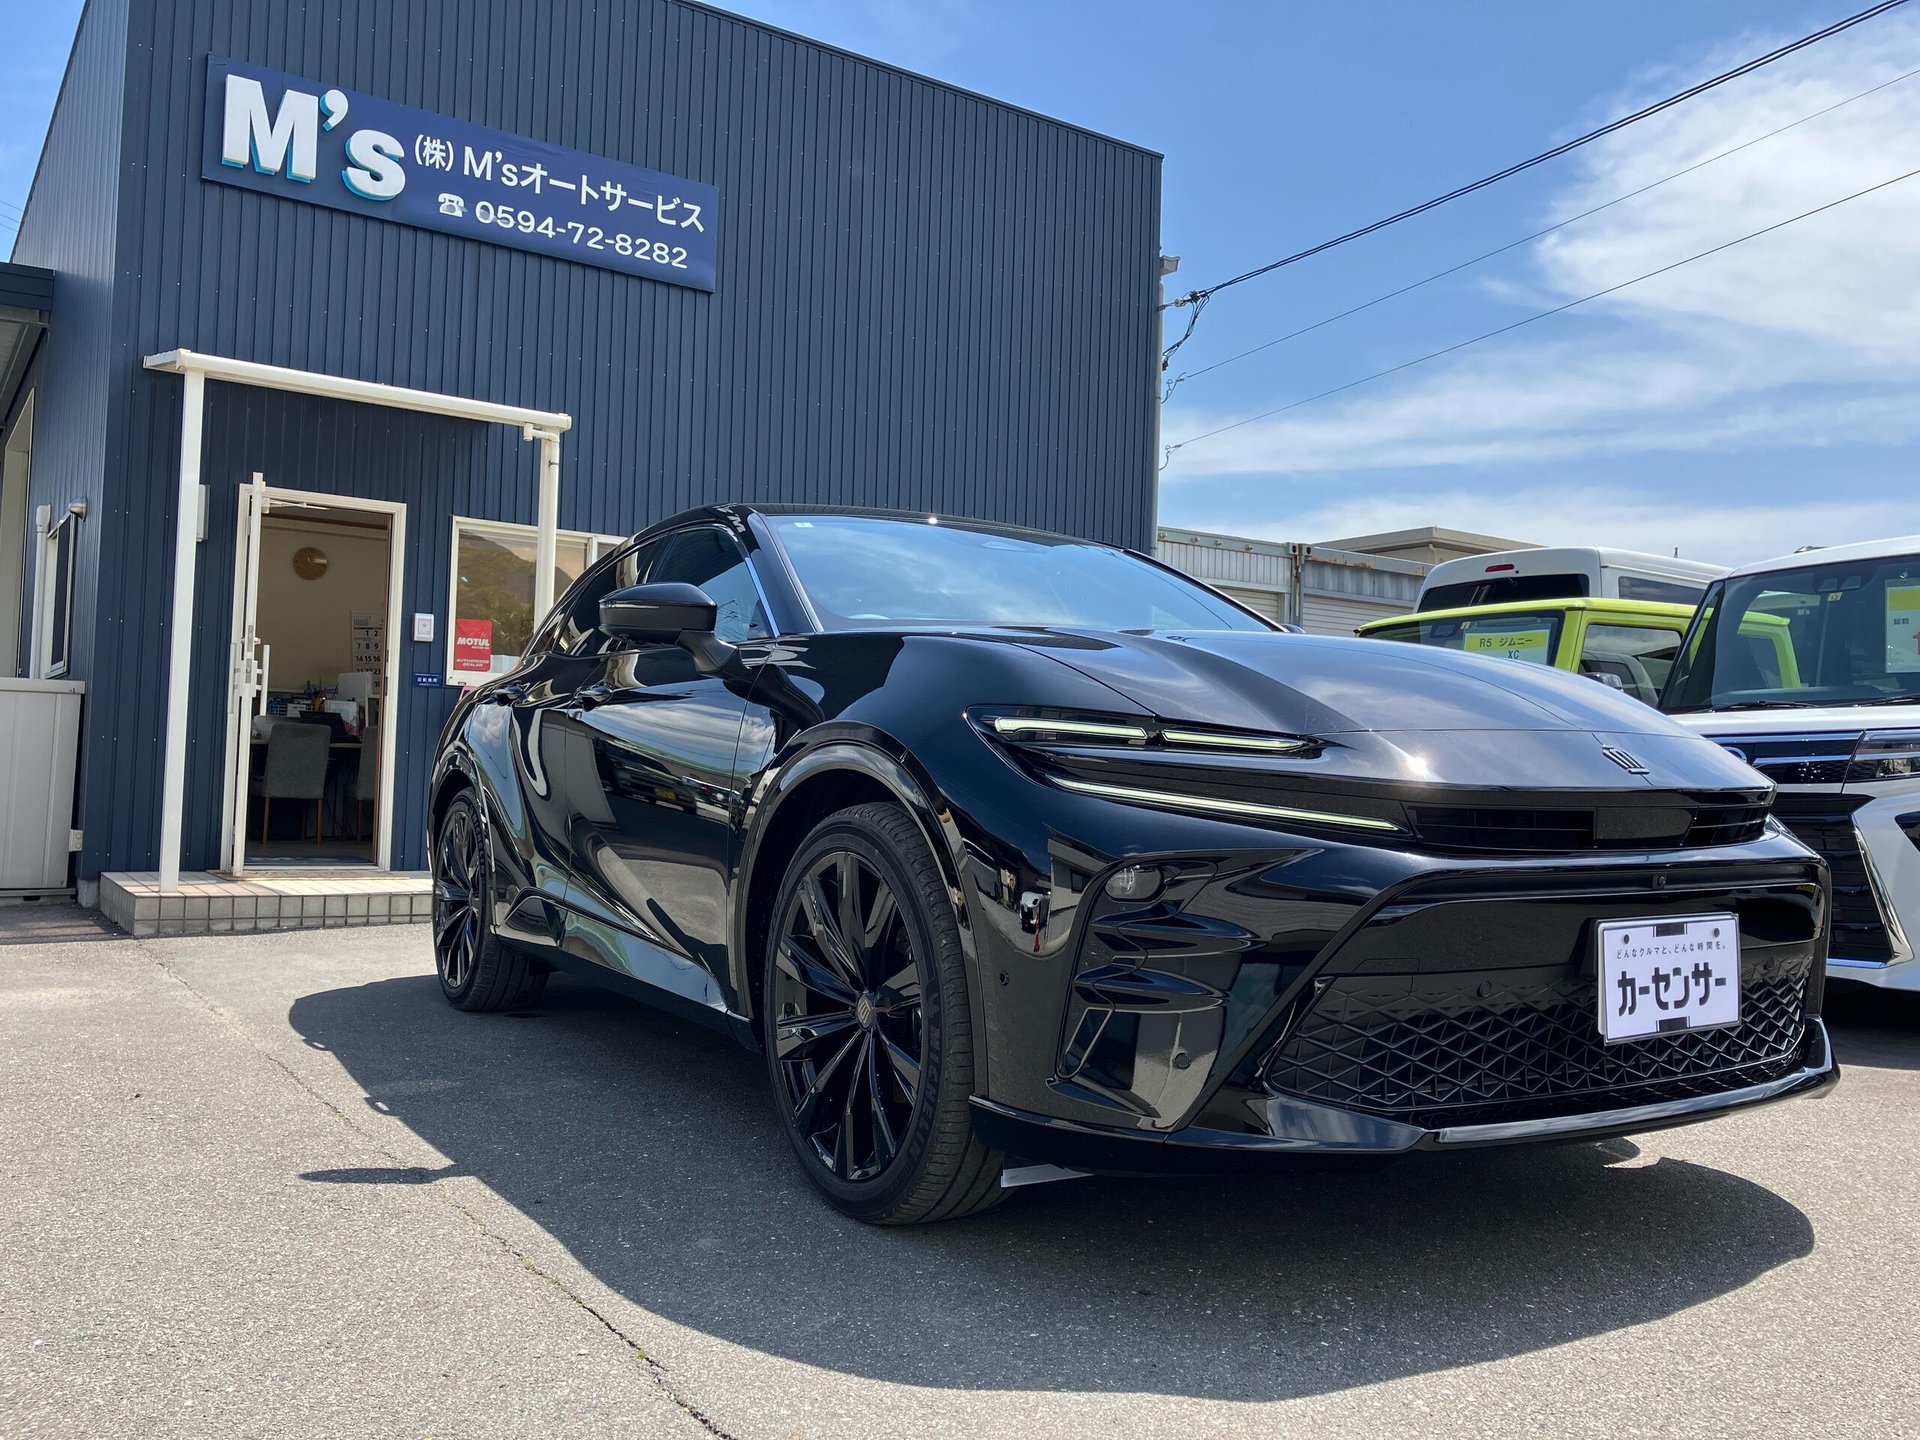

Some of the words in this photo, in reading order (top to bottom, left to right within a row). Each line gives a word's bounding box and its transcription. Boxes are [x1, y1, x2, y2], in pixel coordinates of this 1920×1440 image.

[222, 73, 406, 201] M's
[475, 200, 689, 270] 0594-72-8282
[456, 637, 490, 647] MOTUL
[1479, 638, 1492, 648] R5
[1499, 637, 1533, 647] ジムニー
[1507, 650, 1520, 660] XC
[1617, 961, 1727, 1017] カーセンサー
[907, 1025, 941, 1160] MICHELIN
